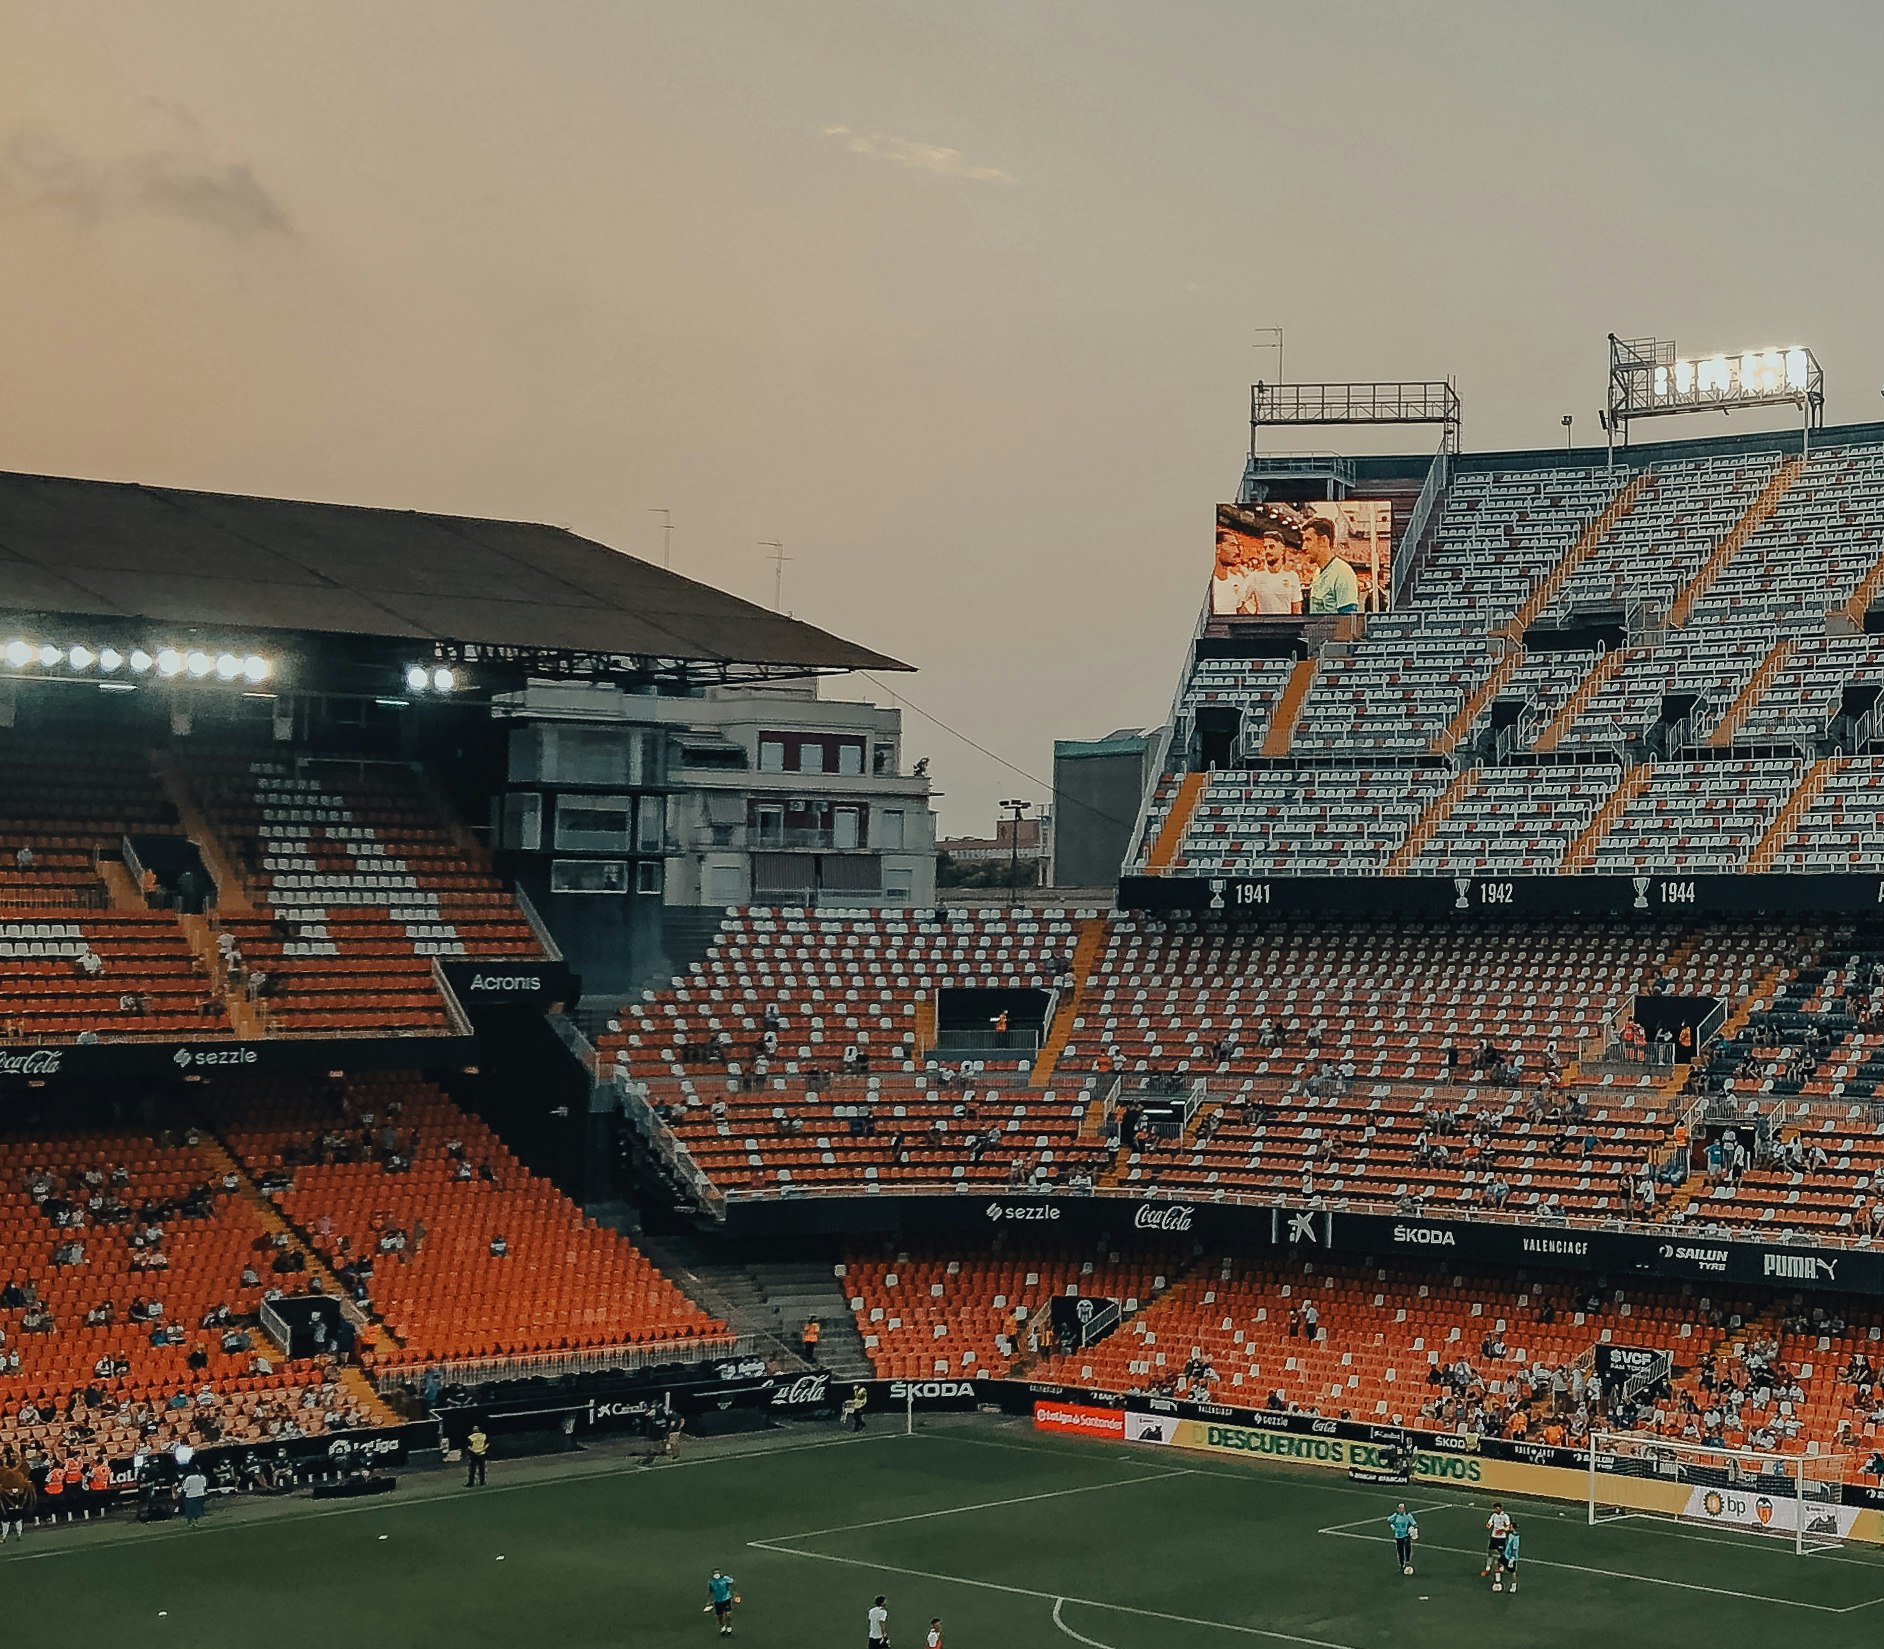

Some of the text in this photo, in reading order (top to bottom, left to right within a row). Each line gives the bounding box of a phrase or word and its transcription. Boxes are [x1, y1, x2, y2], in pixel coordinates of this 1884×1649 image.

[1235, 883, 1271, 904] 1941
[1480, 883, 1514, 904] 1942
[1660, 882, 1696, 903] 1944
[470, 973, 541, 990] Acronis
[0, 1050, 63, 1074] oca-Cola
[195, 1048, 258, 1065] sezzle
[1005, 1204, 1060, 1220] sezzle
[1135, 1204, 1195, 1231] Coca-Cola
[1393, 1224, 1456, 1245] ŠKODA
[1675, 1247, 1729, 1262] SAILUN
[1699, 1261, 1726, 1271] TYRE
[1764, 1254, 1819, 1279] PUMA
[1610, 1349, 1652, 1365] $VCF
[890, 1381, 975, 1398] ŠKODA
[1207, 1426, 1344, 1462] DESCUENTOS
[1435, 1437, 1480, 1451] ŠKOD
[1727, 1496, 1746, 1517] bp
